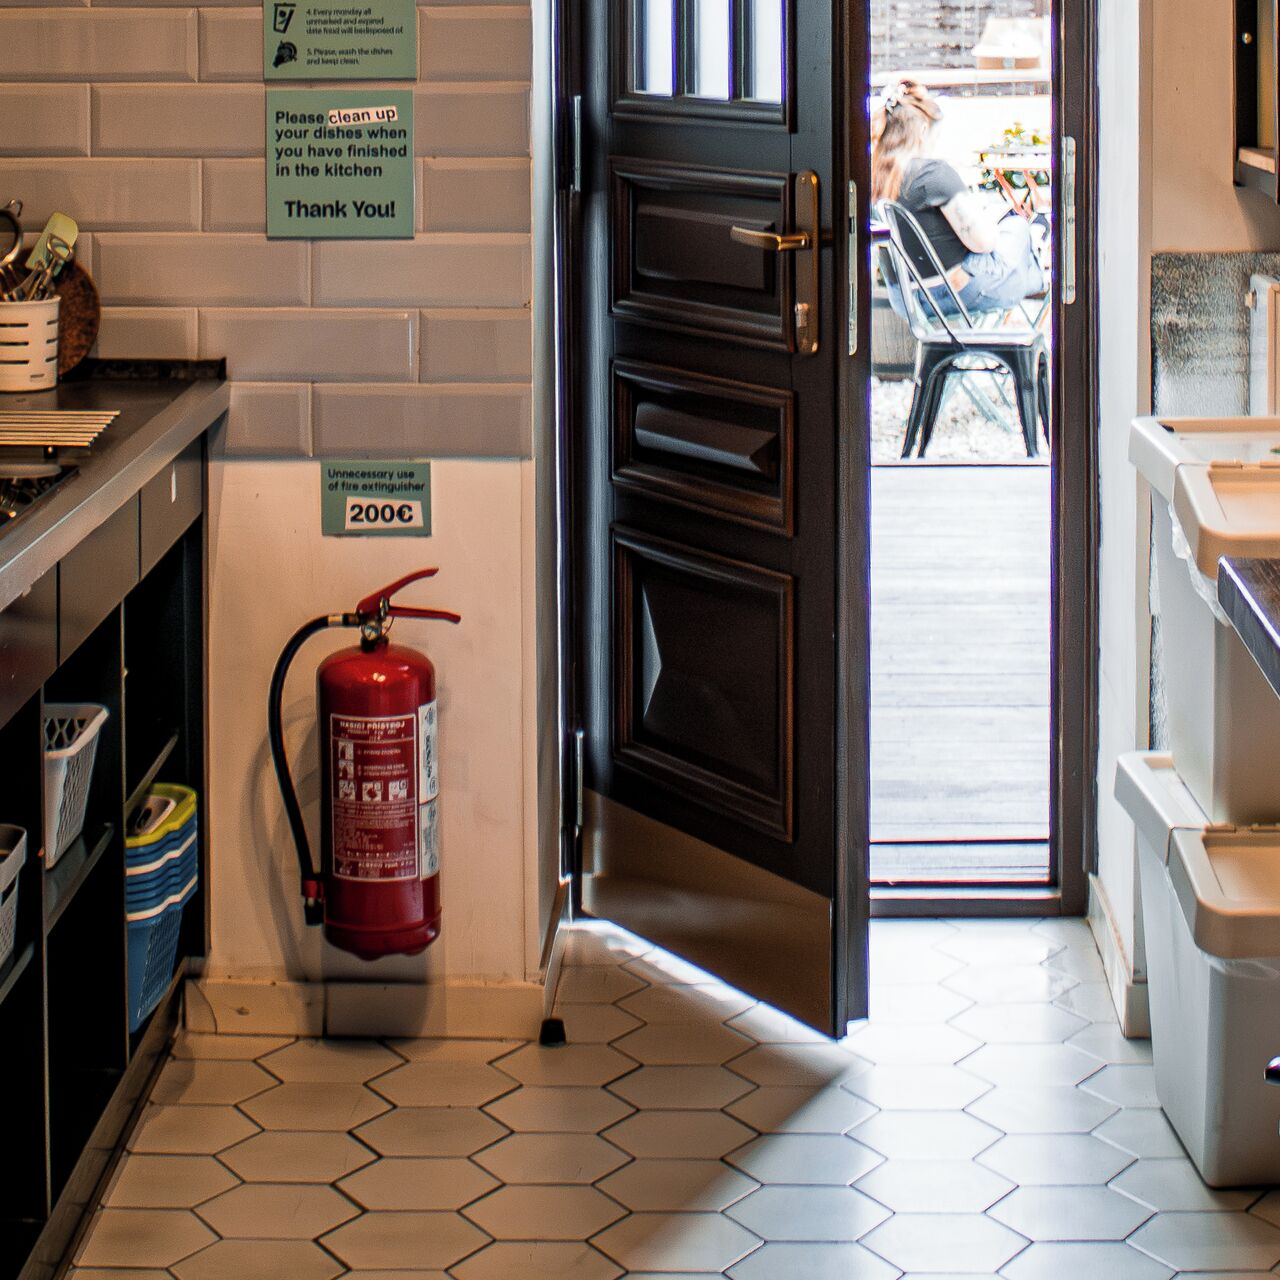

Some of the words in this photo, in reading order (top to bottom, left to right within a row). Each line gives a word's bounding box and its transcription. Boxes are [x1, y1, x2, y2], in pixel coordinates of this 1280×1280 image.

[275, 111, 324, 124] Please
[329, 110, 371, 124] clean
[375, 109, 396, 123] up
[275, 128, 309, 142] your
[313, 126, 363, 139] dishes
[367, 126, 407, 139] when
[275, 147, 303, 160] you
[308, 144, 343, 157] have
[347, 144, 407, 157] finished
[275, 163, 290, 177] in
[295, 163, 320, 177] the
[324, 163, 382, 177] kitchen
[284, 200, 347, 218] Thank
[352, 200, 395, 218] You!
[327, 468, 394, 482] Unnecessary
[397, 470, 415, 478] use
[328, 481, 339, 491] of
[341, 481, 359, 491] fire
[361, 482, 425, 493] extinguisher
[349, 503, 414, 523] 200€
